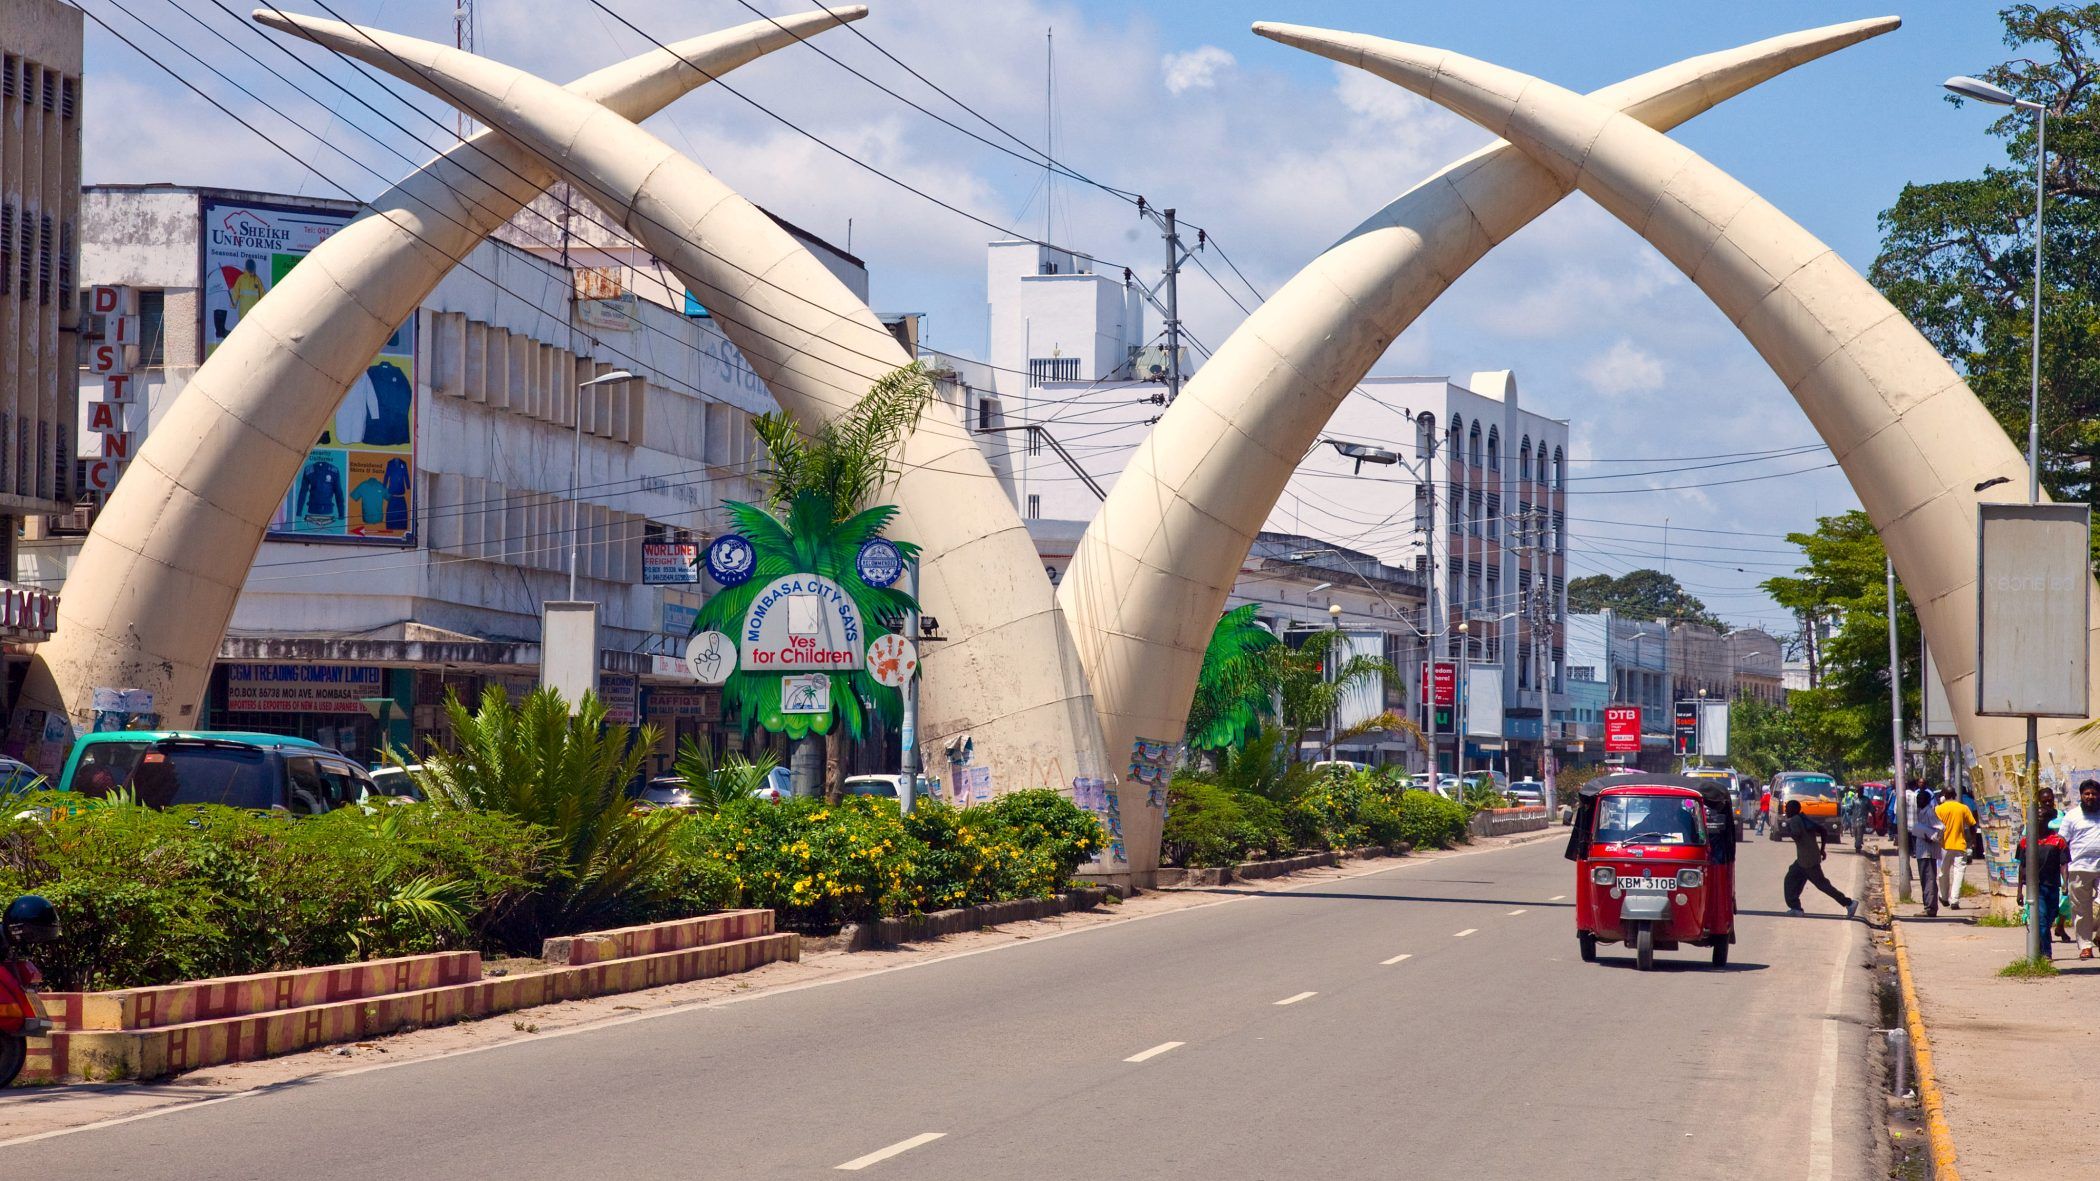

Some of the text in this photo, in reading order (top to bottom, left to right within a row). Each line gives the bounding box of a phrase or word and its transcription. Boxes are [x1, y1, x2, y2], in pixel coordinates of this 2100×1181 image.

[212, 229, 282, 251] UNIFORMS
[211, 248, 267, 261] Seasonal Dressing
[91, 287, 128, 504] DISTANC
[644, 544, 697, 556] WORLDNET
[645, 557, 677, 565] FREIGHT
[748, 581, 858, 642] MOMBASA CITY SAYS
[789, 635, 816, 648] Yes
[752, 648, 853, 664] for Children
[301, 665, 343, 683] COMPANY
[345, 666, 380, 684] LIMITED
[315, 688, 352, 699] MOMBASA
[1608, 710, 1636, 720] DTB
[1617, 877, 1677, 890] KBM 310B
